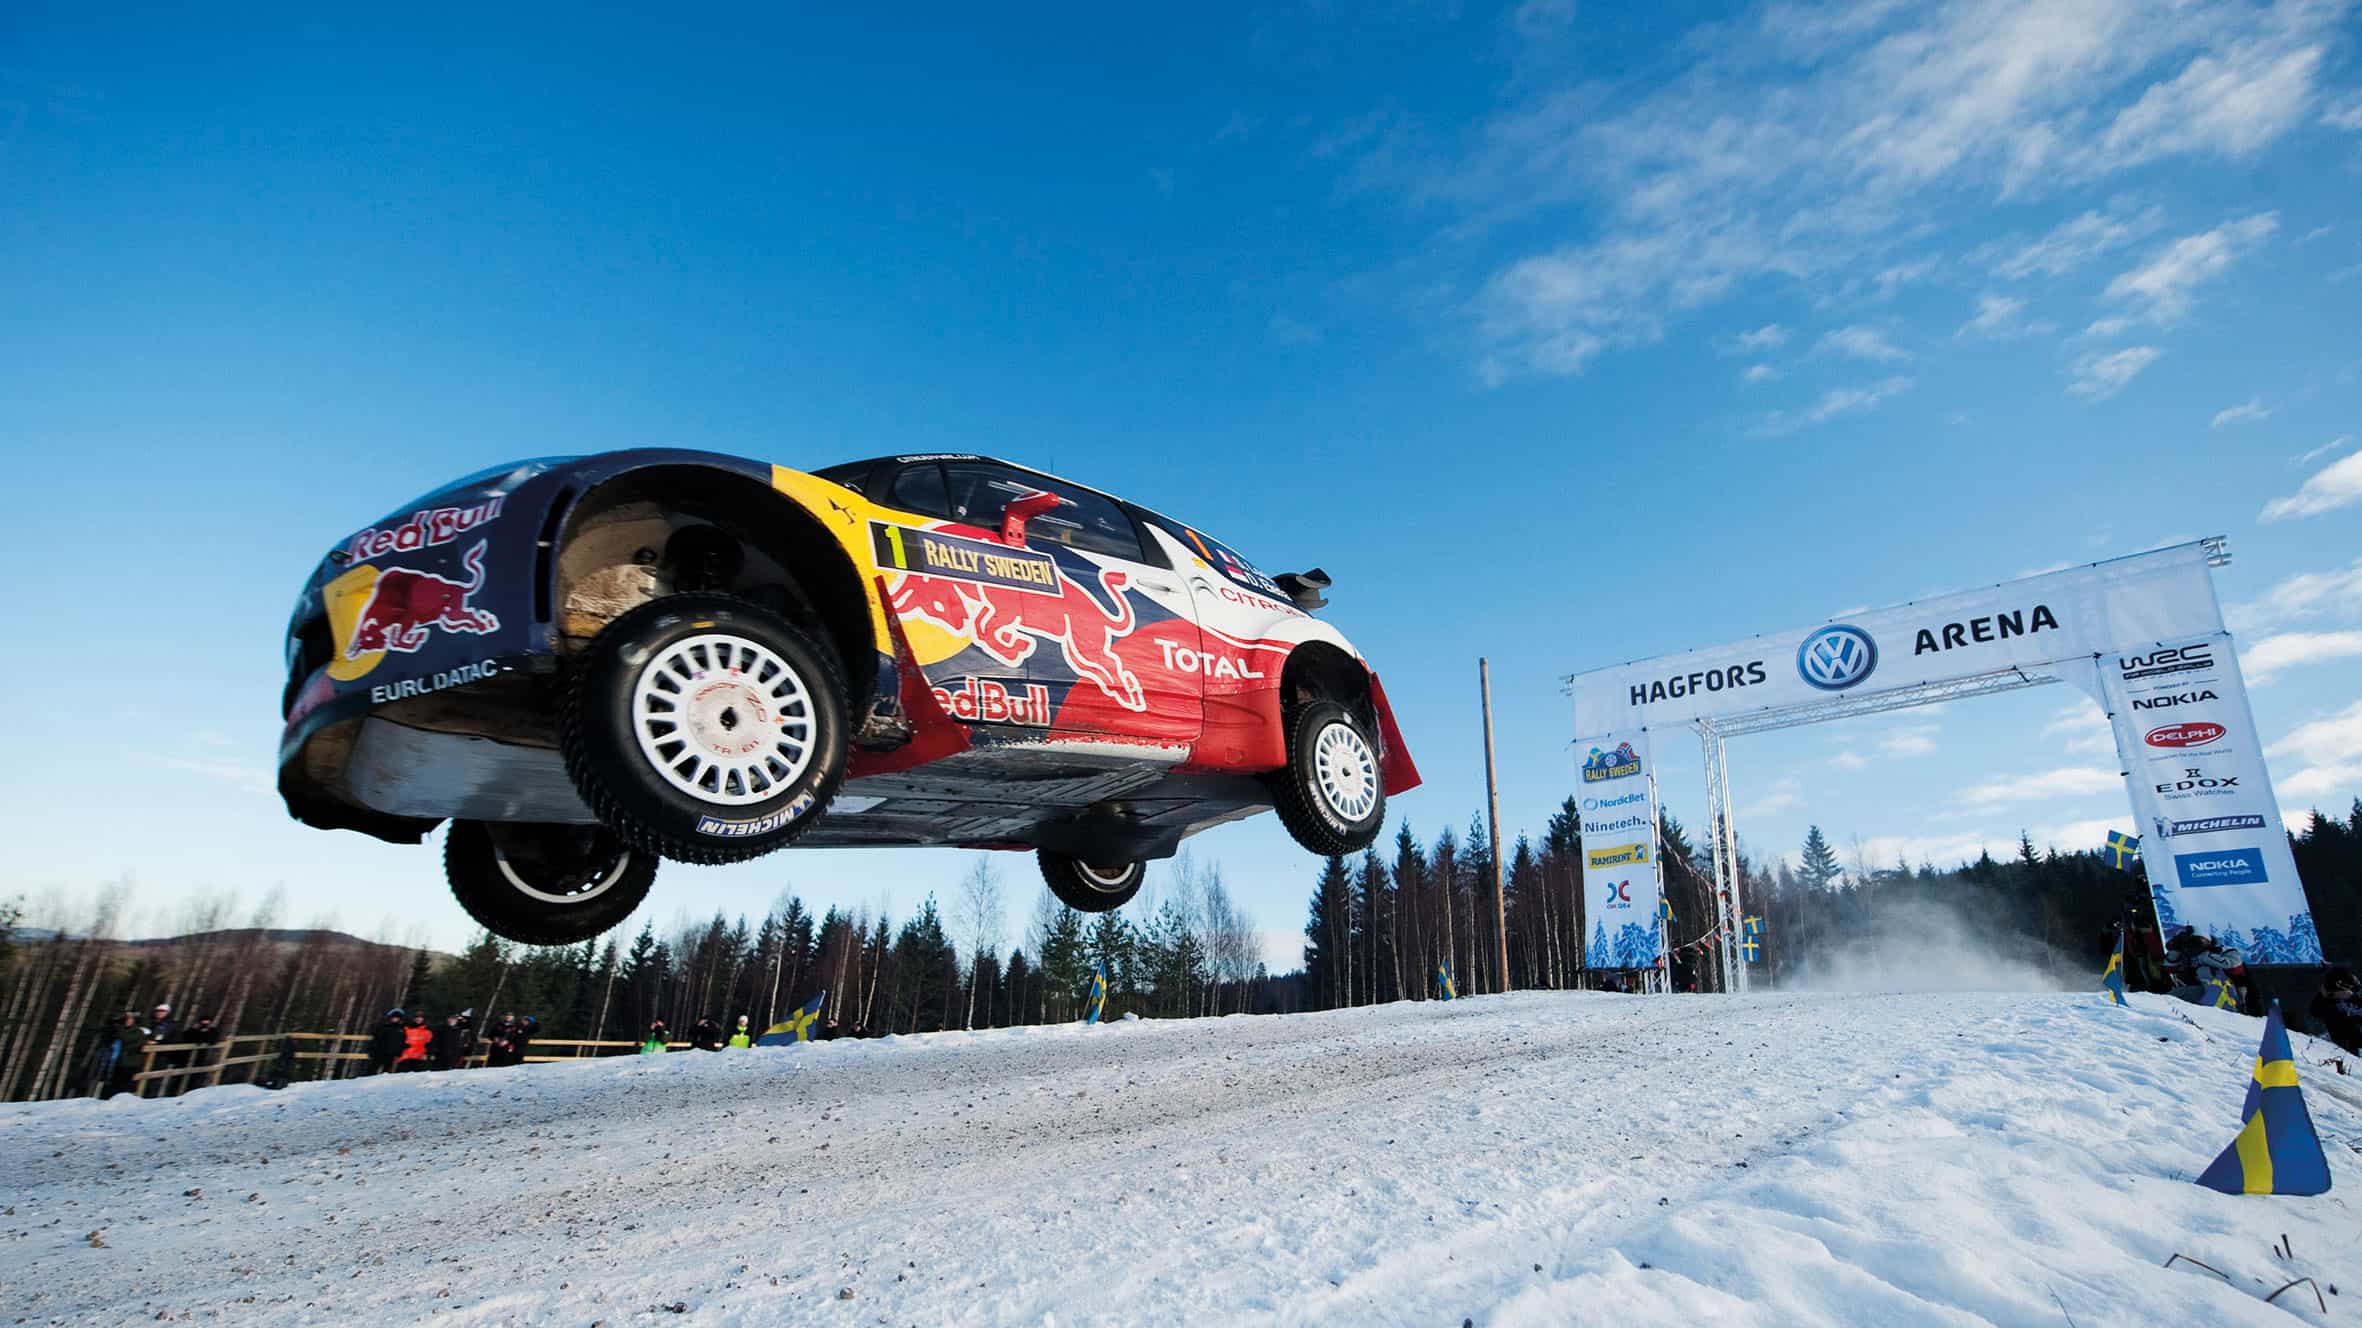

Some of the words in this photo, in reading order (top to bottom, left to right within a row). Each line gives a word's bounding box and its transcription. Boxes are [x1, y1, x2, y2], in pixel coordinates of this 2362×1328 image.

[344, 511, 428, 568] Red
[427, 497, 504, 547] Bull
[1185, 529, 1214, 561] 1
[884, 525, 907, 569] 1
[923, 538, 979, 573] RALLY
[983, 555, 1054, 586] SWEDEN
[1914, 605, 2059, 655] ARENA
[1153, 637, 1264, 679] TOTAL
[2120, 643, 2211, 670] WRC
[1630, 661, 1766, 706] HAGFORS
[931, 675, 980, 720] ed
[980, 680, 1050, 726] Bull
[2132, 690, 2219, 710] NOKIA
[2152, 727, 2217, 742] DELPHI
[1585, 768, 1607, 781] RALLY
[1609, 761, 1640, 778] SWEDEN
[2156, 777, 2240, 793] EDOX
[1600, 793, 1644, 808] NordicBet
[700, 807, 797, 835] MICHELIN
[2177, 817, 2260, 831] MICHELIN
[1591, 852, 1632, 865] RAMIRENT
[2190, 859, 2248, 871] NOKIA
